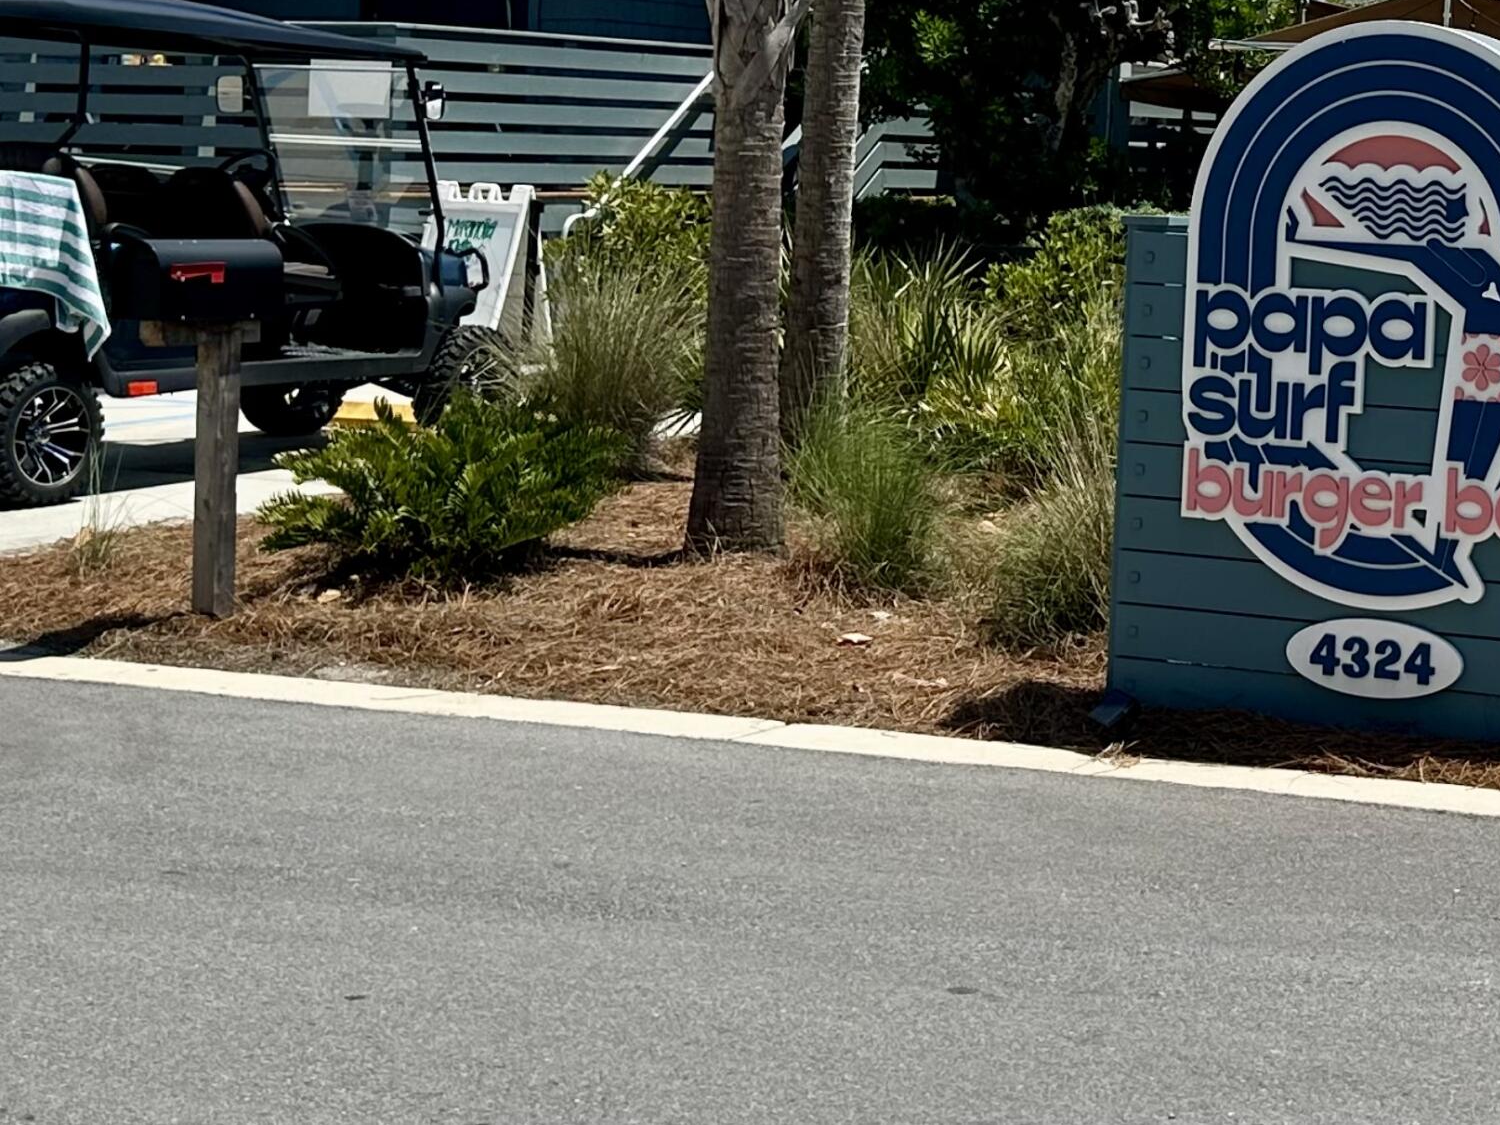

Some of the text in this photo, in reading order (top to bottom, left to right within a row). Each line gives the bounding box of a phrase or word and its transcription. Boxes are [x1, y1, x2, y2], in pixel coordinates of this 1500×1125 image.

[1193, 289, 1428, 375] papa
[1188, 361, 1357, 443] surf
[1185, 447, 1423, 549] burger
[1309, 633, 1436, 686] 4324
